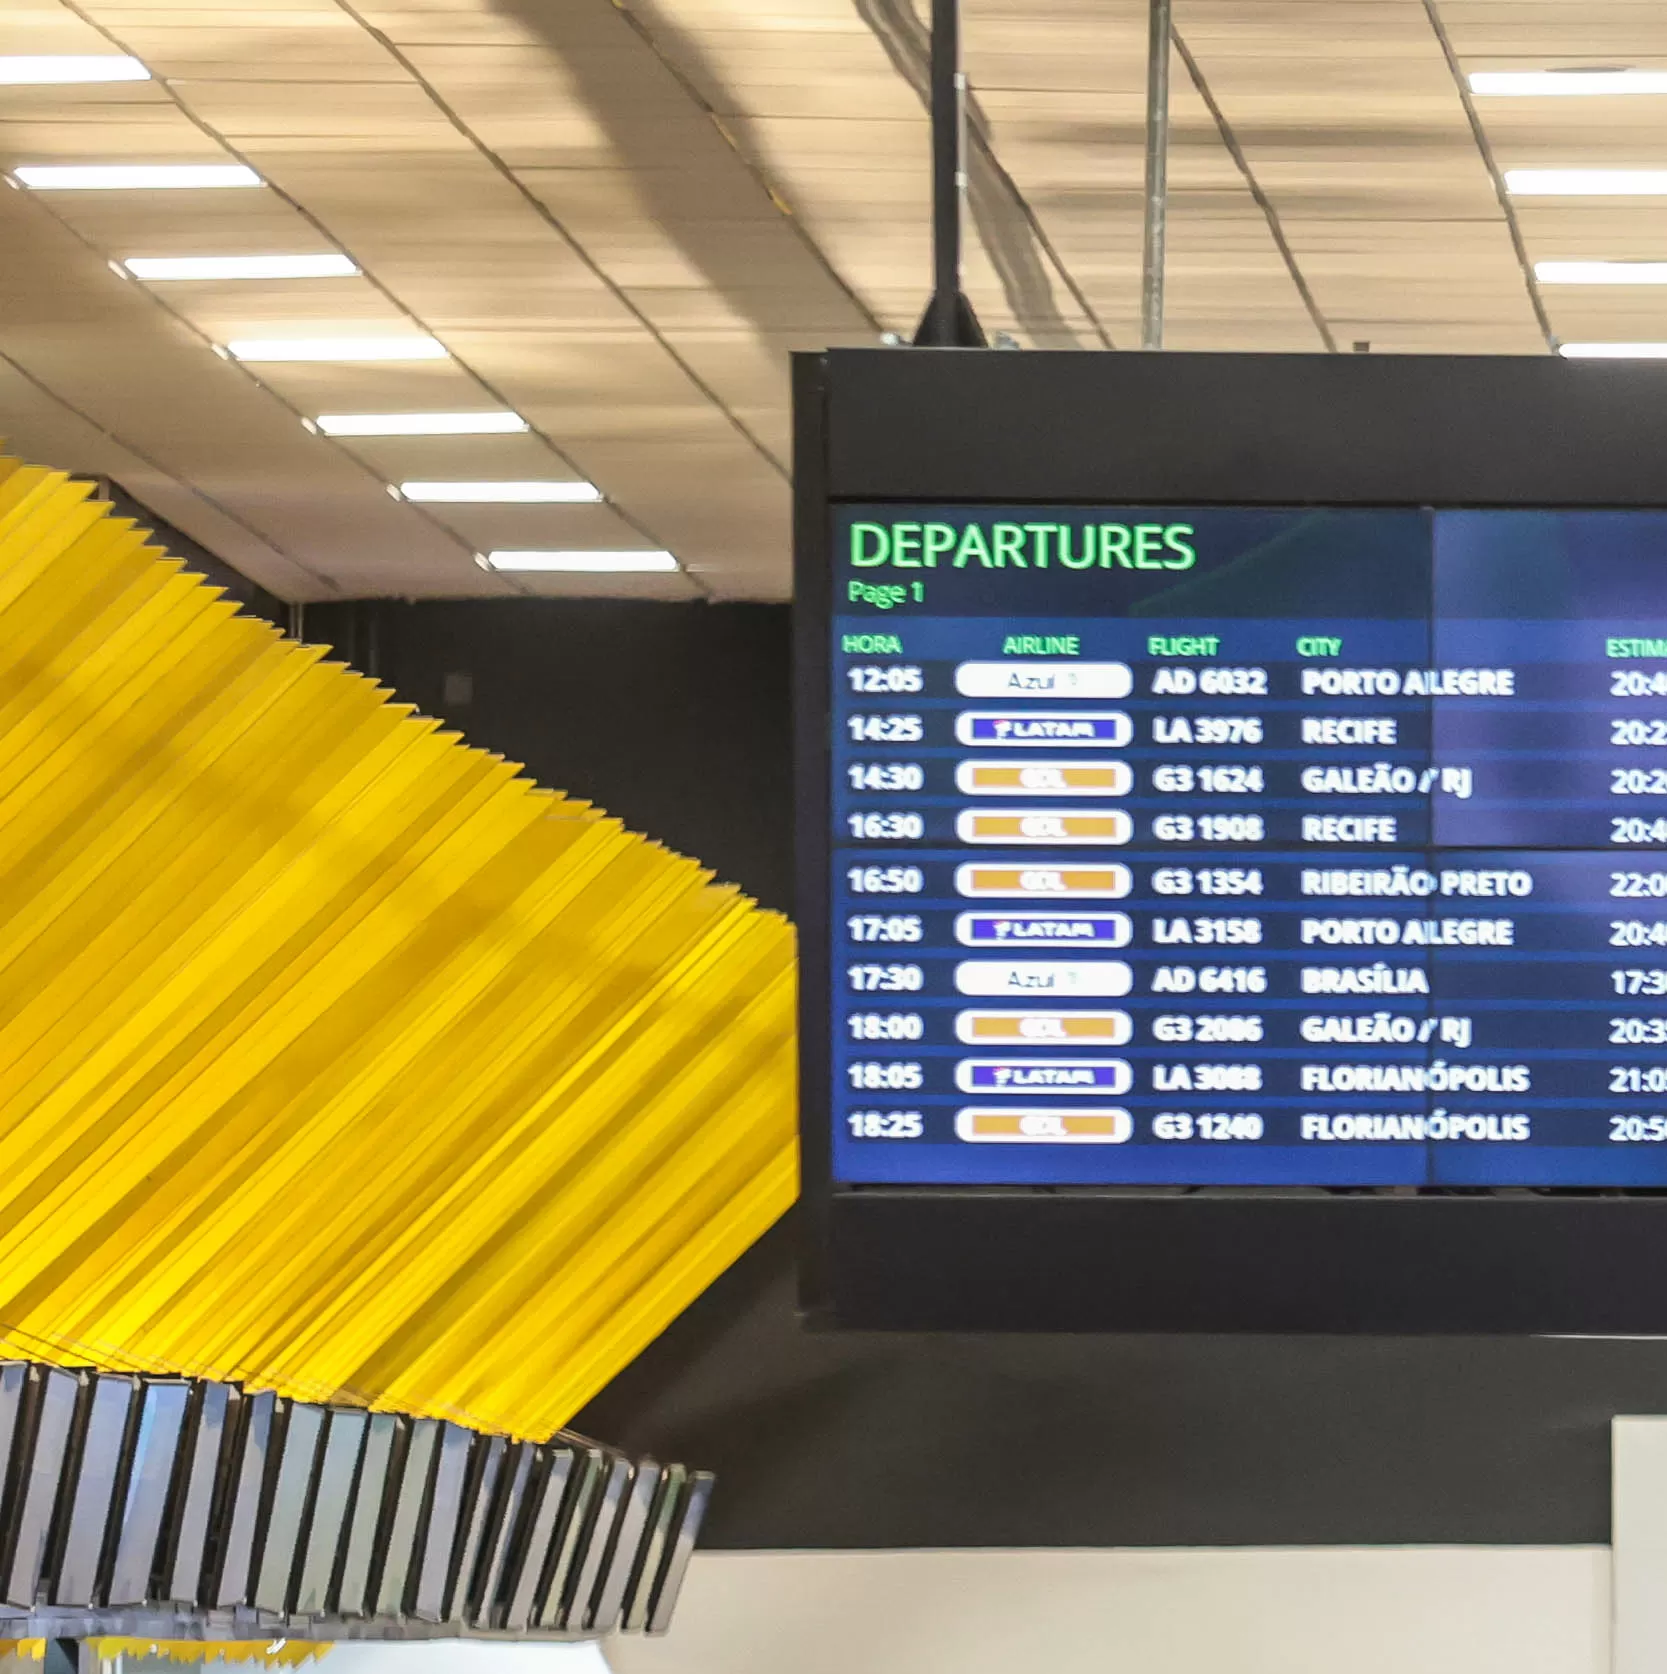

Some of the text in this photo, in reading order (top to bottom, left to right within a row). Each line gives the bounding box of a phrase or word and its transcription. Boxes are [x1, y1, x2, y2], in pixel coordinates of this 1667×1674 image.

[851, 522, 1195, 569] DEPARTURES
[849, 581, 923, 609] Page 1
[842, 634, 903, 654] HORA
[1003, 635, 1080, 655] AIRLINE
[1148, 636, 1220, 656] FLIGHT
[1296, 636, 1342, 656] CITY
[1302, 669, 1400, 695] PORTO
[1403, 669, 1514, 695] ALEGRE
[1303, 719, 1396, 744] RECIFE
[1302, 763, 1415, 793] GALEÃO
[1442, 767, 1472, 798] RJ
[1303, 816, 1396, 841] RECIFE
[1302, 866, 1437, 895] RIBEIRÃO
[1441, 871, 1532, 896] PRETO
[1302, 919, 1400, 944] PORTO
[1402, 919, 1513, 945] ALEGRE
[1302, 963, 1429, 993] BRASÍLIA
[1301, 1012, 1415, 1042] GALEÃO
[1441, 1018, 1471, 1047] RJ
[1302, 1061, 1530, 1091] FLORIANÓPOLIS
[1302, 1110, 1530, 1140] FLORIANÓPOLIS
